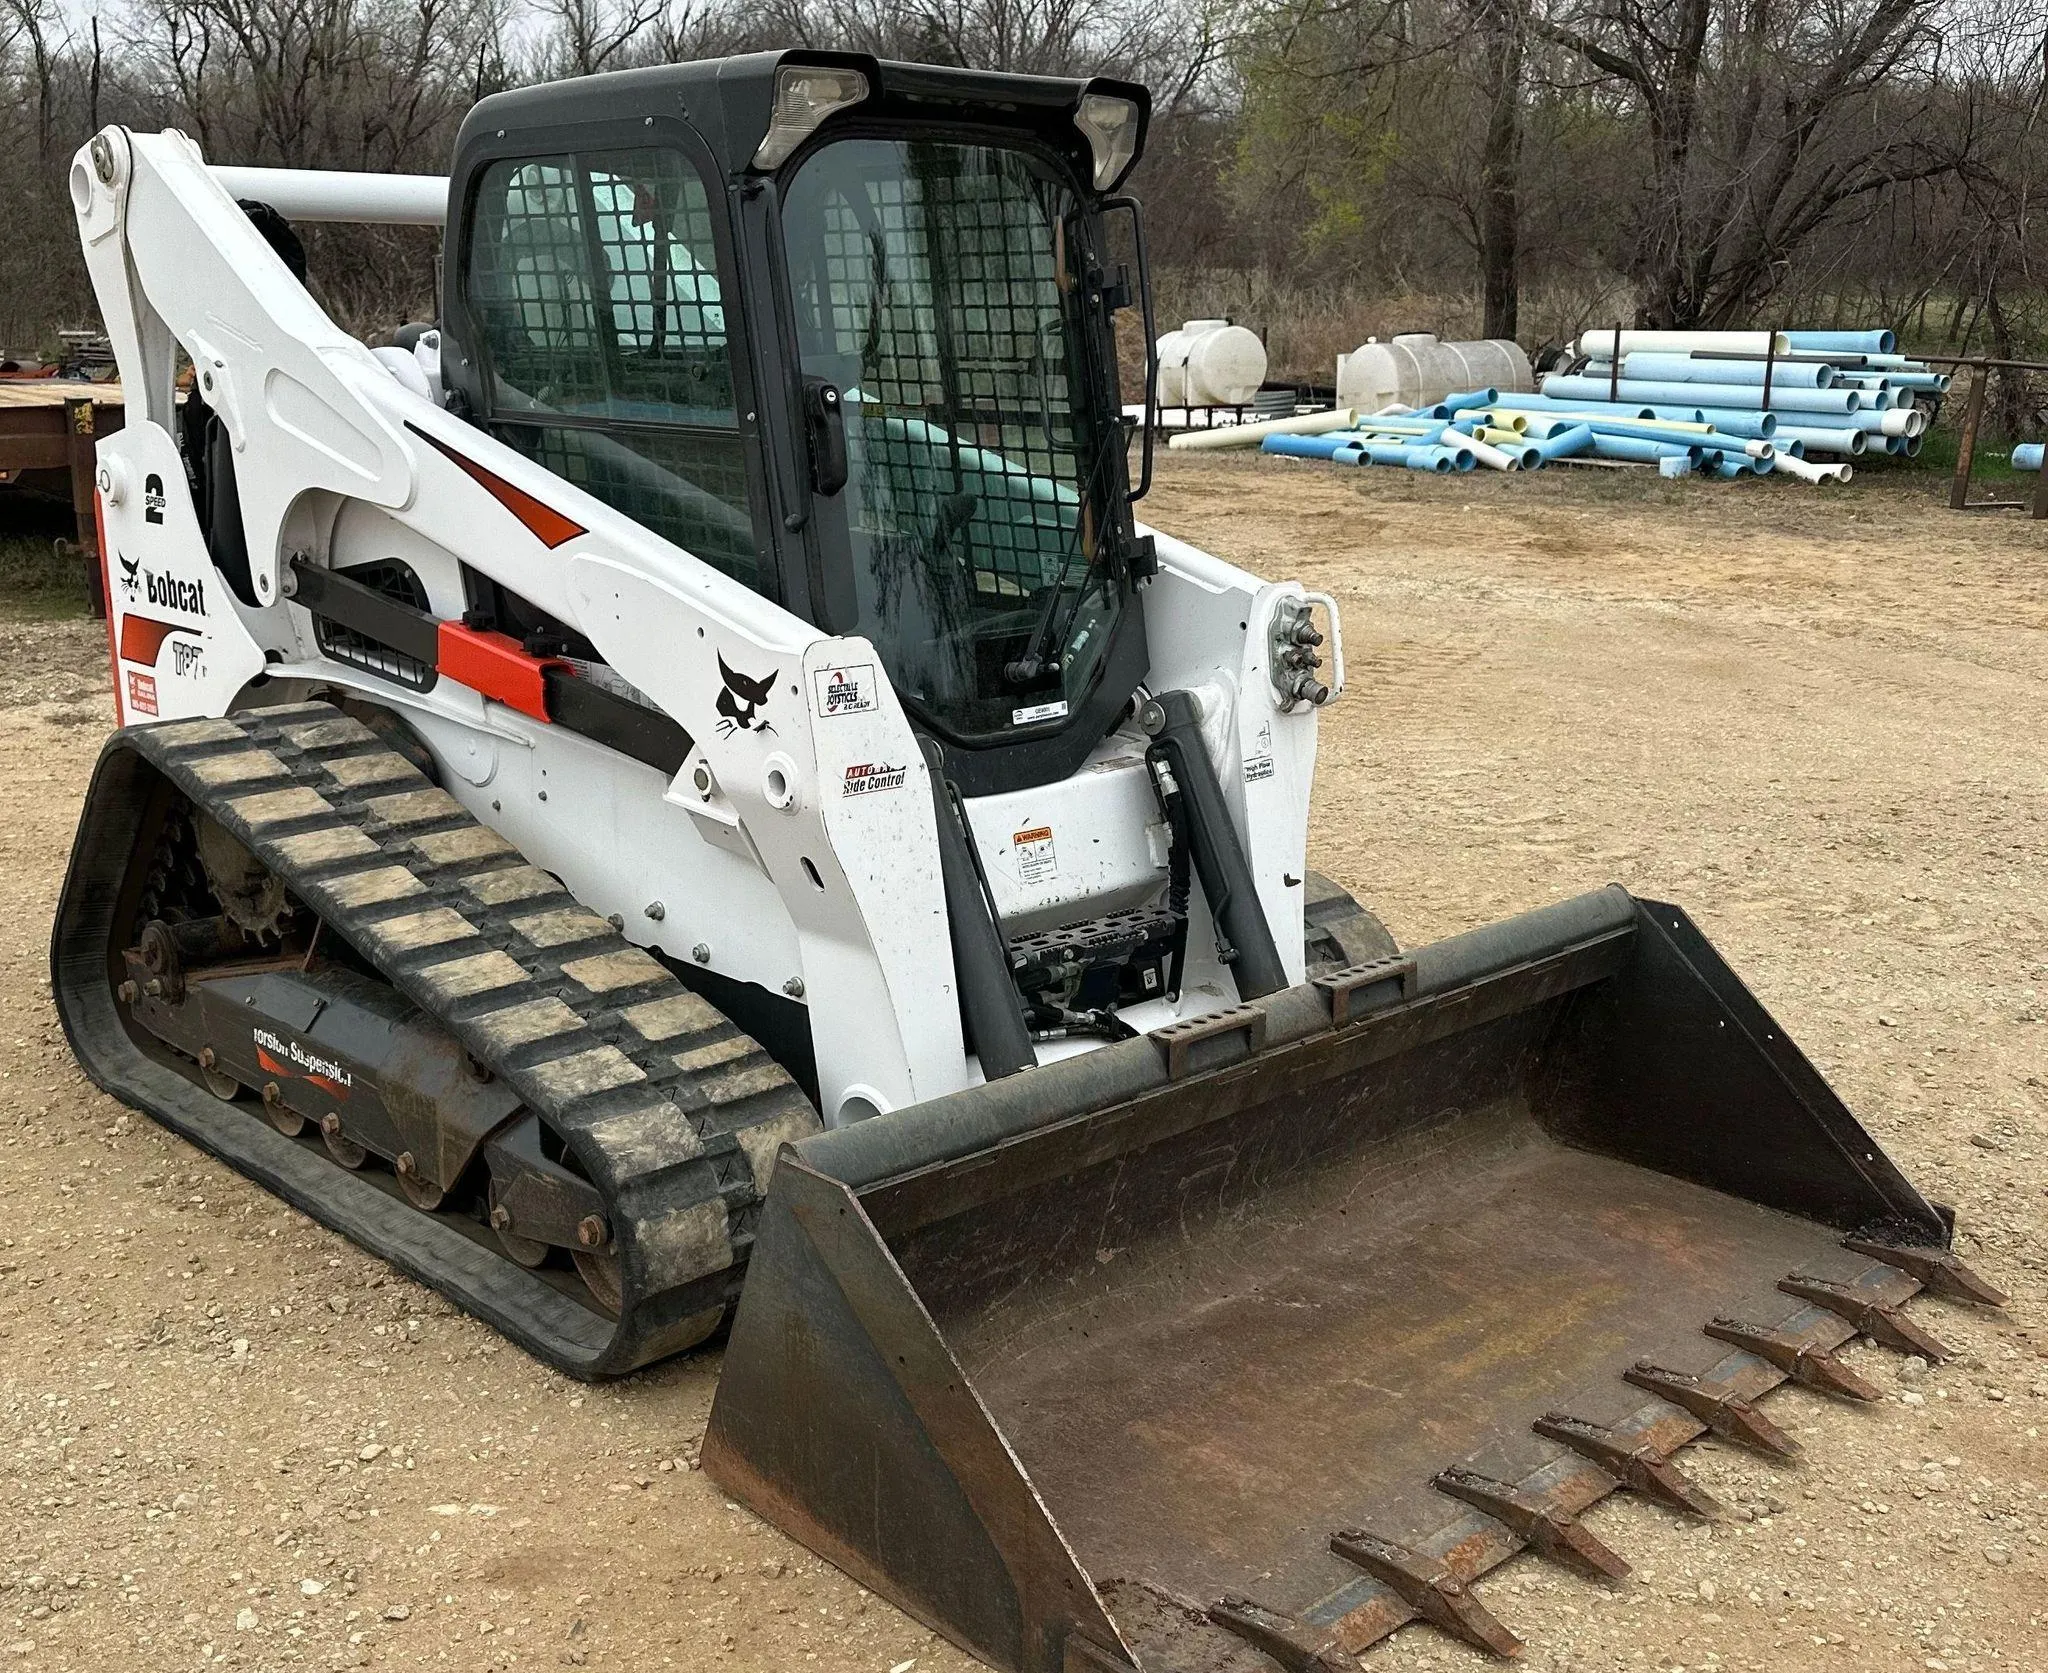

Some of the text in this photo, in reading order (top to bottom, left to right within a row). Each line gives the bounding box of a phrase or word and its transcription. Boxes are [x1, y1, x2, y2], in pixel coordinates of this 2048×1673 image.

[145, 473, 164, 525] 2
[145, 495, 166, 508] SPEED
[143, 569, 207, 617] Bobcat
[172, 640, 208, 681] T87
[867, 771, 905, 790] Control
[1021, 829, 1049, 841] WARNING
